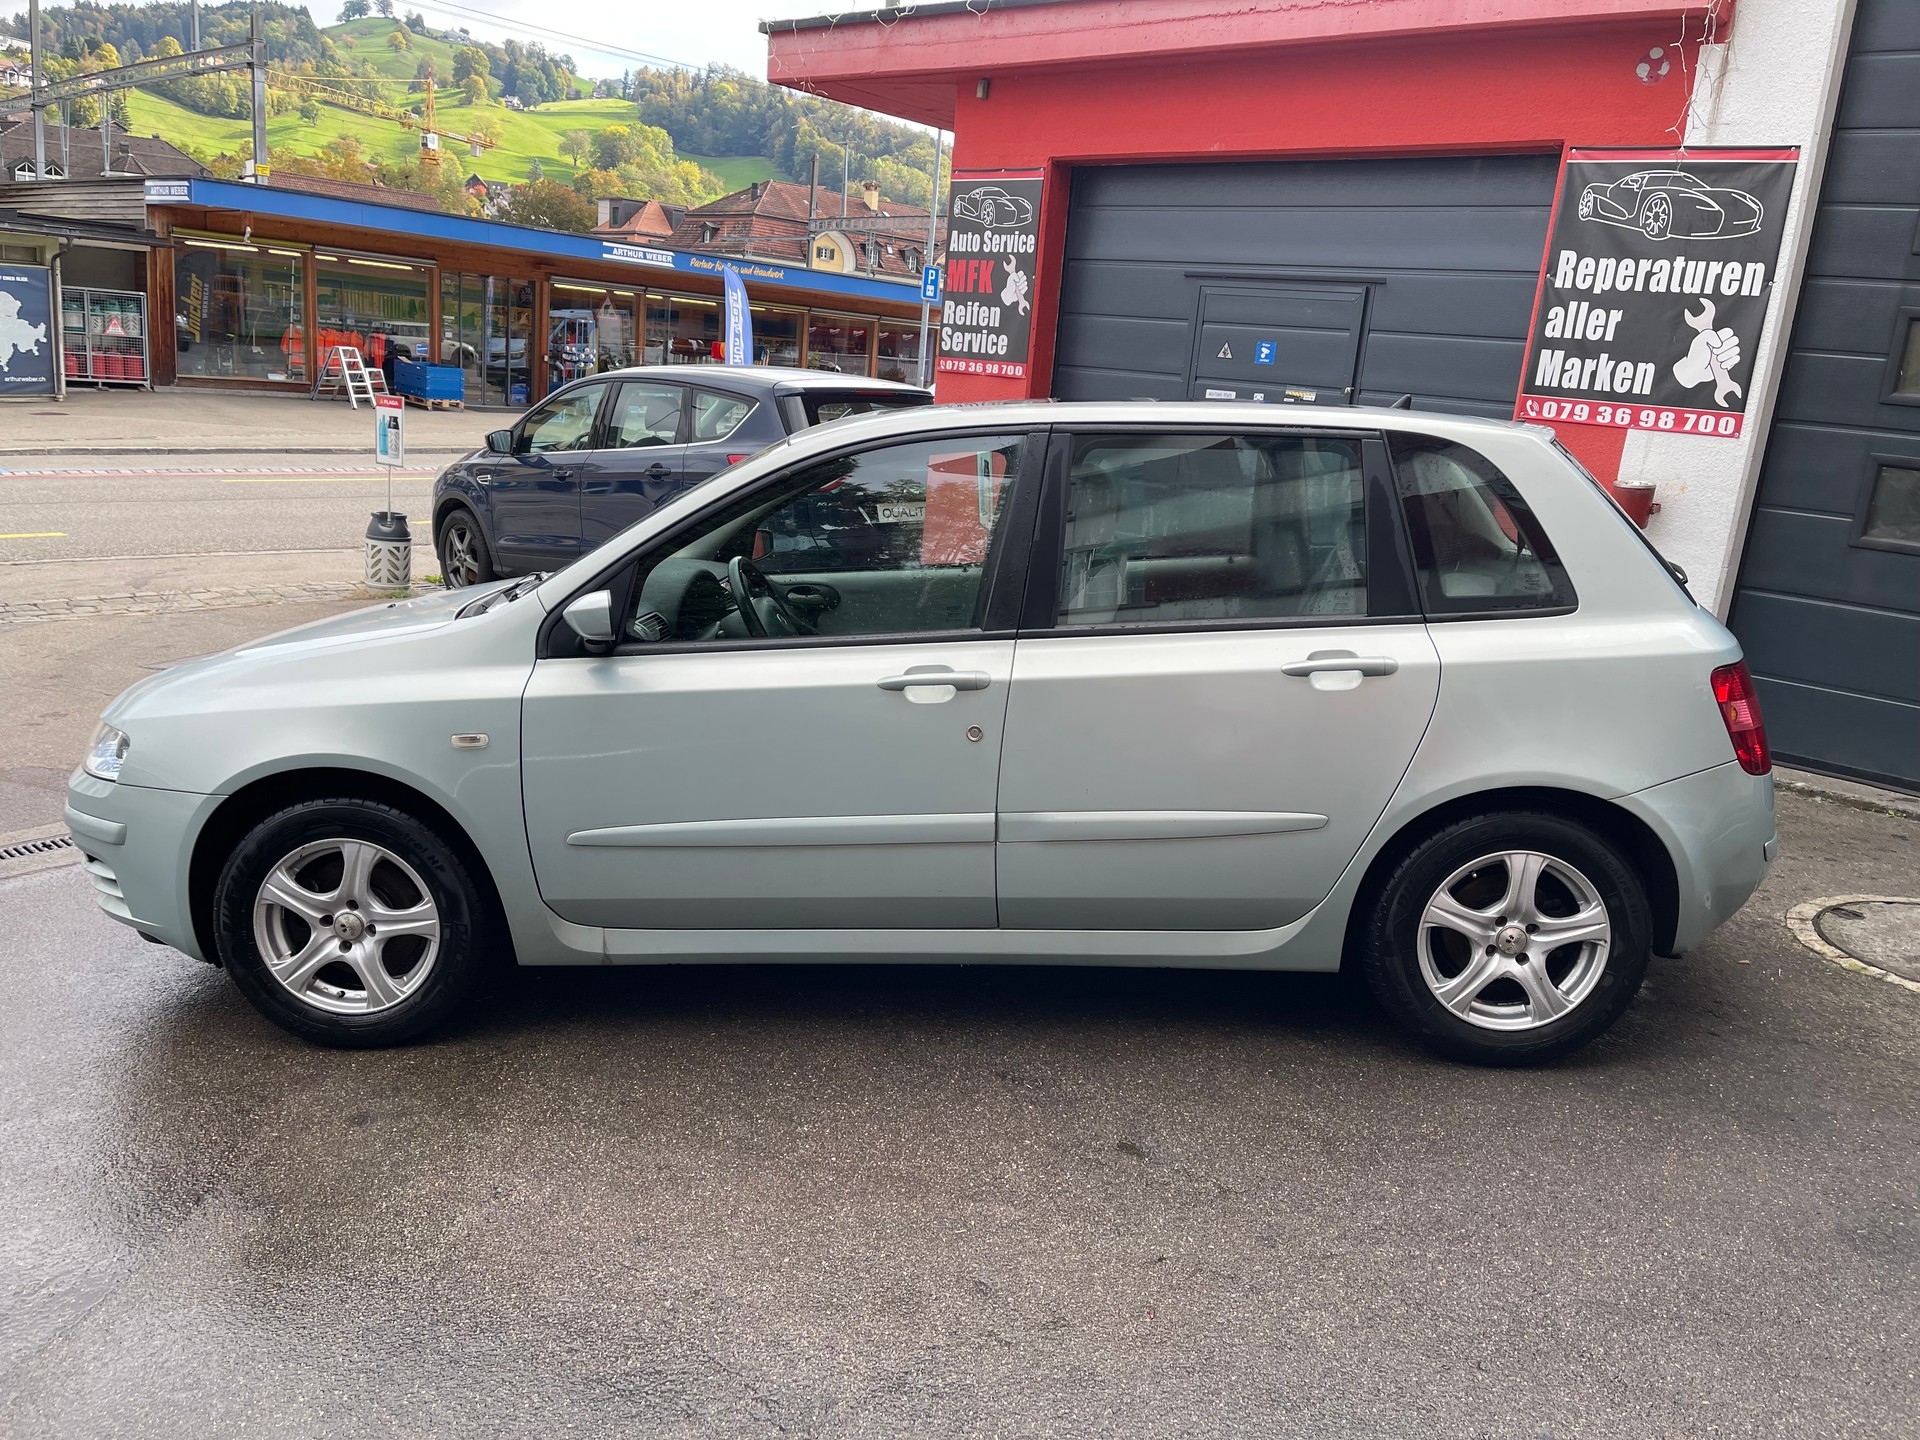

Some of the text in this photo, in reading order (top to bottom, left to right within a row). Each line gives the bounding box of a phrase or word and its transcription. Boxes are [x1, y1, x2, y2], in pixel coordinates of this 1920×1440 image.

[151, 186, 188, 195] ARTHUR WEBER
[612, 247, 673, 263] ARTHUR WEBER
[949, 230, 1035, 254] Auto Service
[689, 257, 714, 270] Partner
[753, 267, 785, 280] Handwerk
[928, 269, 935, 284] P
[946, 259, 995, 294] MFK
[1554, 249, 1766, 297] Reperaturen
[202, 282, 210, 319] WORKWEAR
[943, 300, 1001, 328] Reifen
[1544, 301, 1624, 342] aller
[941, 326, 1008, 356] Service
[946, 360, 1024, 377] 079 36 98 700
[1535, 349, 1656, 395] Marken
[1542, 401, 1736, 436] 079 36 98 700
[882, 506, 925, 519] QUALIT
